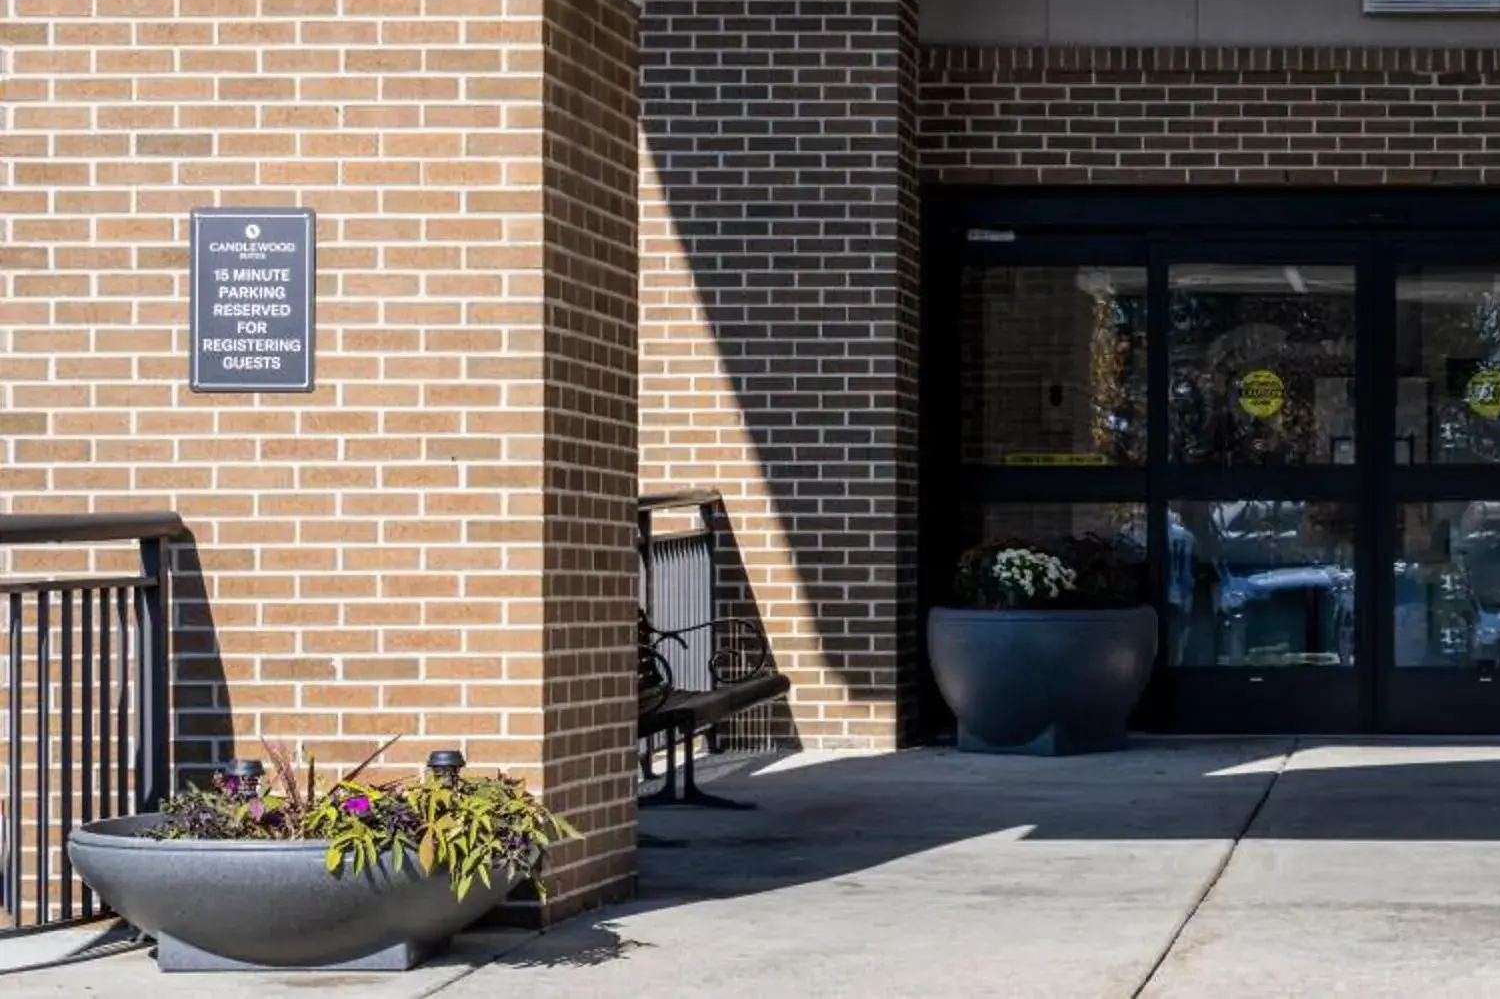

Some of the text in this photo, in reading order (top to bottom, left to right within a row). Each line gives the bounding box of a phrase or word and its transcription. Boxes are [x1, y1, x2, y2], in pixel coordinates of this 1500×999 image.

[209, 242, 296, 253] CANDLEWOOD
[213, 269, 290, 282] 15 MINUTE
[218, 286, 286, 299] PARKING
[213, 304, 291, 316] RESERVED
[237, 321, 267, 334] FOR
[202, 339, 302, 352] REGISTERING
[222, 356, 281, 370] GUESTS
